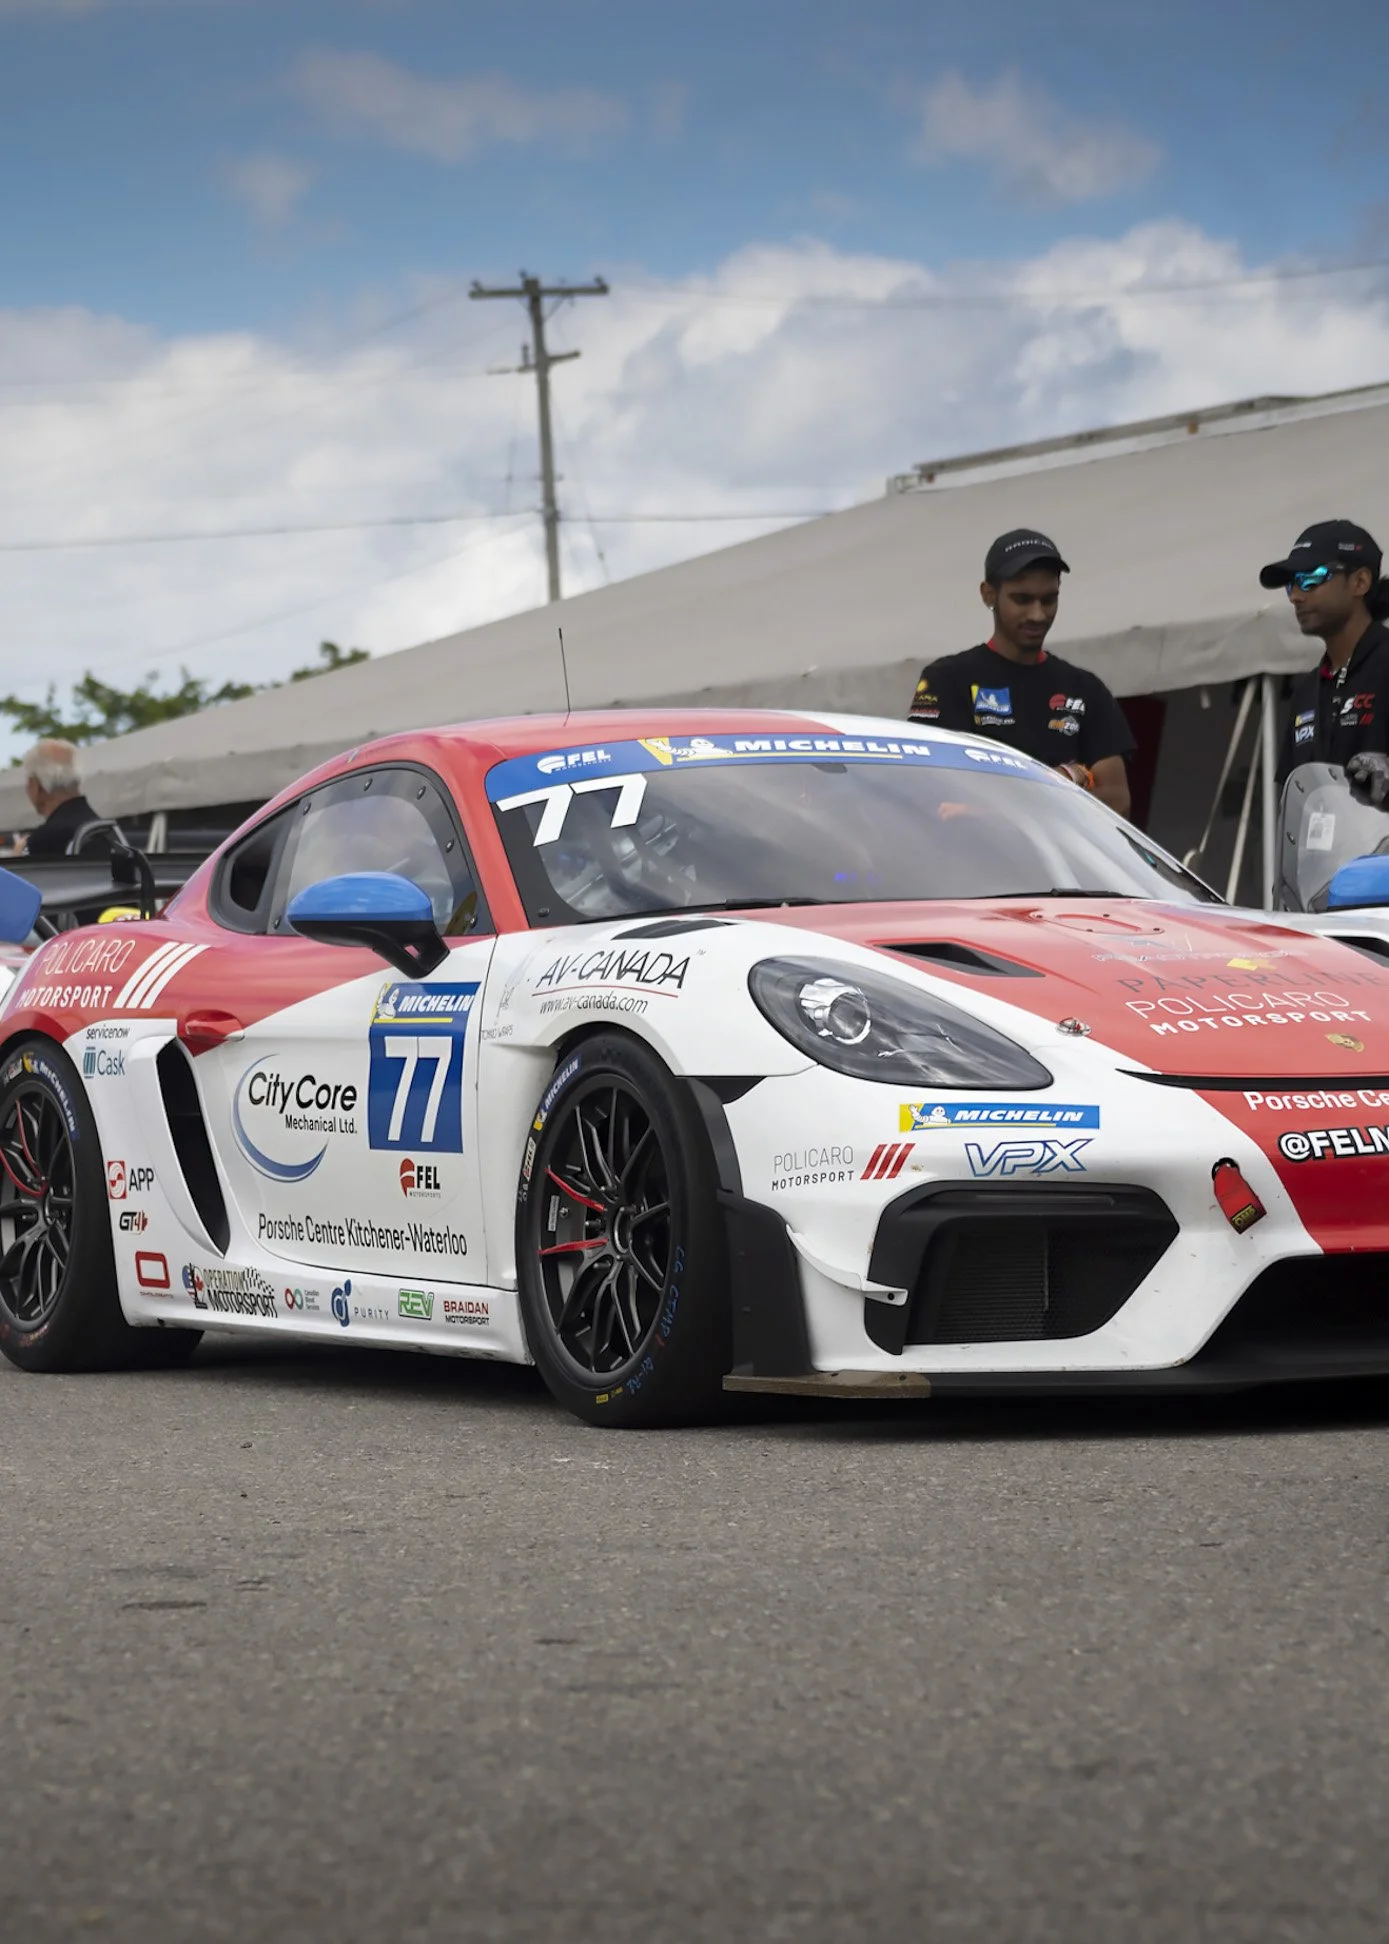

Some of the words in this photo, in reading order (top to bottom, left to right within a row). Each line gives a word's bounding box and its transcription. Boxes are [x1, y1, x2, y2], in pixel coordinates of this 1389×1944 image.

[567, 749, 611, 766] FEL
[734, 740, 931, 756] MICHELIN
[496, 772, 648, 847] 77
[35, 939, 136, 976] POLICARO
[536, 949, 691, 989] AV-CANADA
[16, 985, 113, 1009] MOTORSPORT
[398, 994, 475, 1012] MICHELIN
[539, 991, 649, 1015] www.av-canada.com
[1125, 991, 1350, 1019] POLICARO
[86, 1025, 130, 1040] servicenow
[1150, 1010, 1372, 1036] MOTORSPORT
[97, 1050, 125, 1076] Cask
[40, 1061, 76, 1132] MICHELIN
[384, 1036, 453, 1143] 77
[544, 1058, 579, 1111] MICHELIN
[1243, 1091, 1357, 1111] Porsche
[285, 1114, 336, 1132] Mechanical
[338, 1117, 358, 1134] Ltd.
[954, 1110, 1084, 1122] MICHELIN
[773, 1145, 854, 1174] POLICARO
[964, 1138, 1095, 1178] VPX
[129, 1168, 154, 1191] APP
[417, 1165, 441, 1190] FEL
[771, 1171, 854, 1192] MOTORSPORT
[258, 1213, 304, 1240] Porsche
[305, 1215, 345, 1246] Centre
[345, 1218, 468, 1256] Kitchener-Waterloo
[203, 1268, 245, 1292] OPERATION
[207, 1289, 278, 1318] MOTORSPORT
[354, 1306, 389, 1320] PURITY
[398, 1288, 434, 1320] REV
[444, 1301, 489, 1315] BRAIDAN
[445, 1315, 490, 1326] MOTORSPORT
